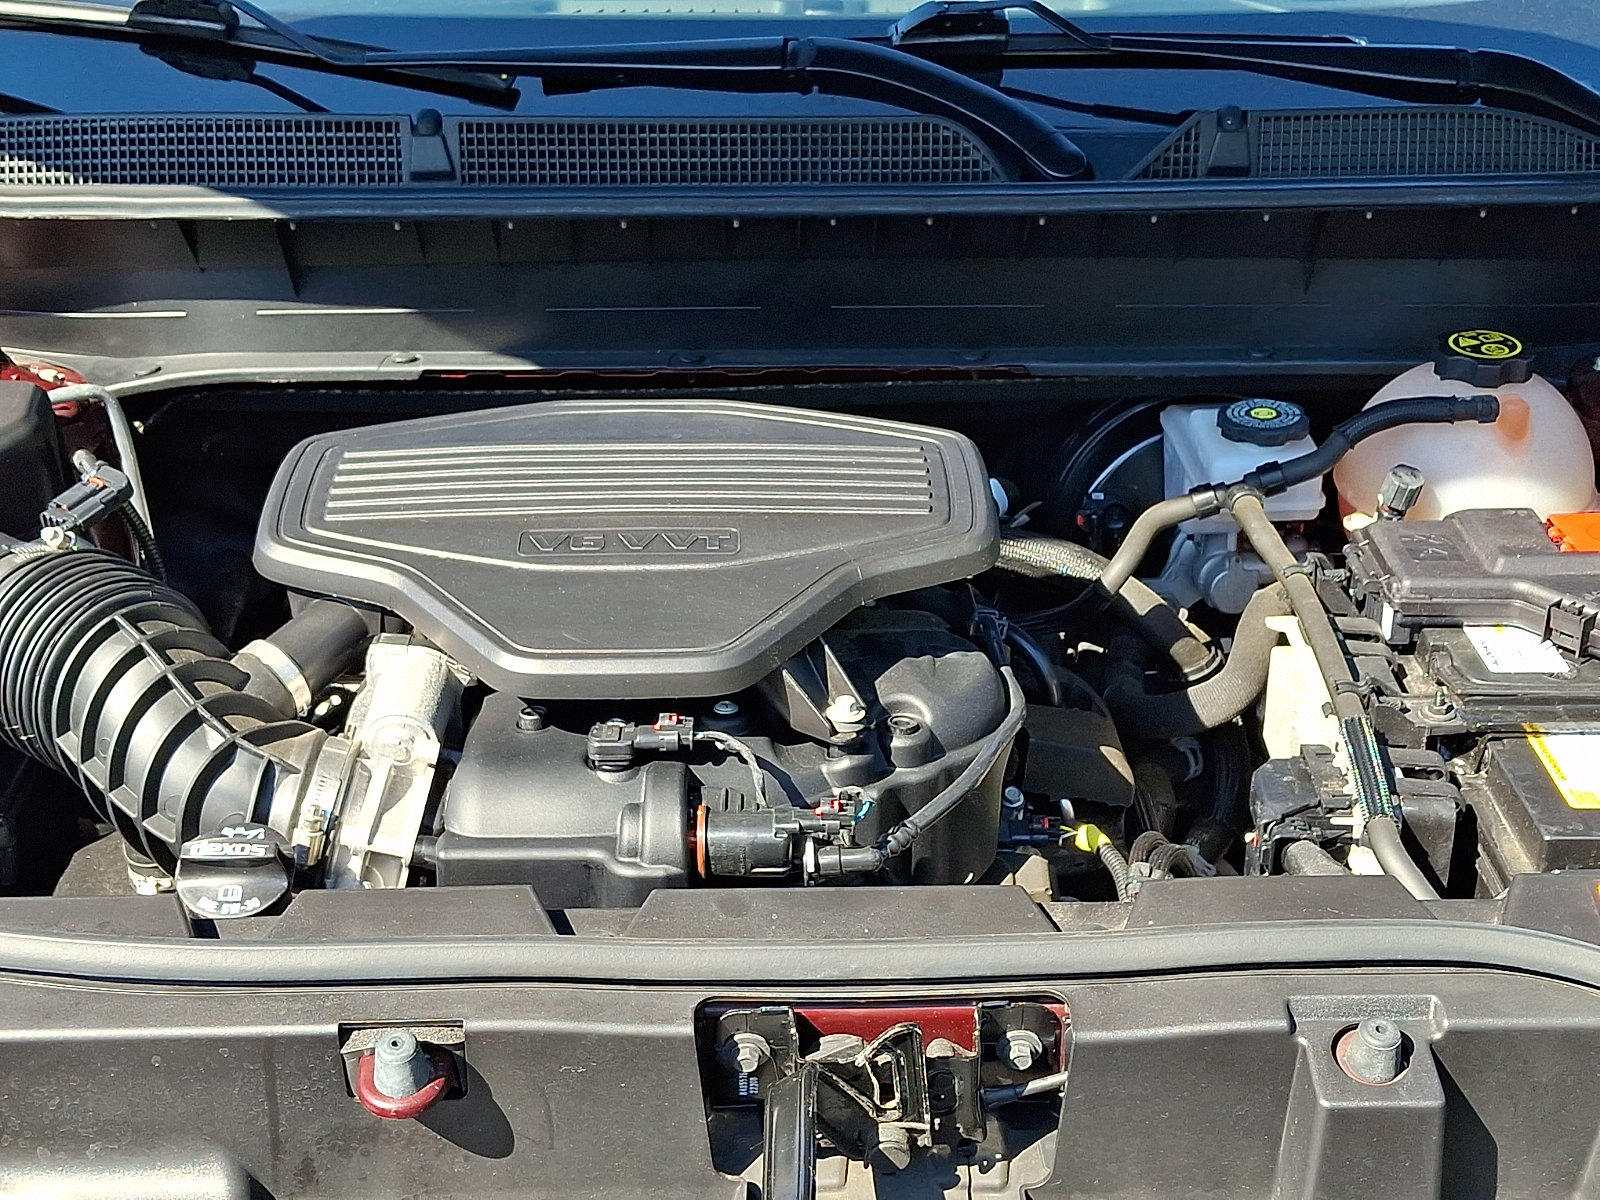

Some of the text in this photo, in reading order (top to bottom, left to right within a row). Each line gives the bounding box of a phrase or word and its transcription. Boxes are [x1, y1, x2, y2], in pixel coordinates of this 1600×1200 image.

[528, 531, 731, 551] V6 VVT
[189, 842, 270, 857] dexos
